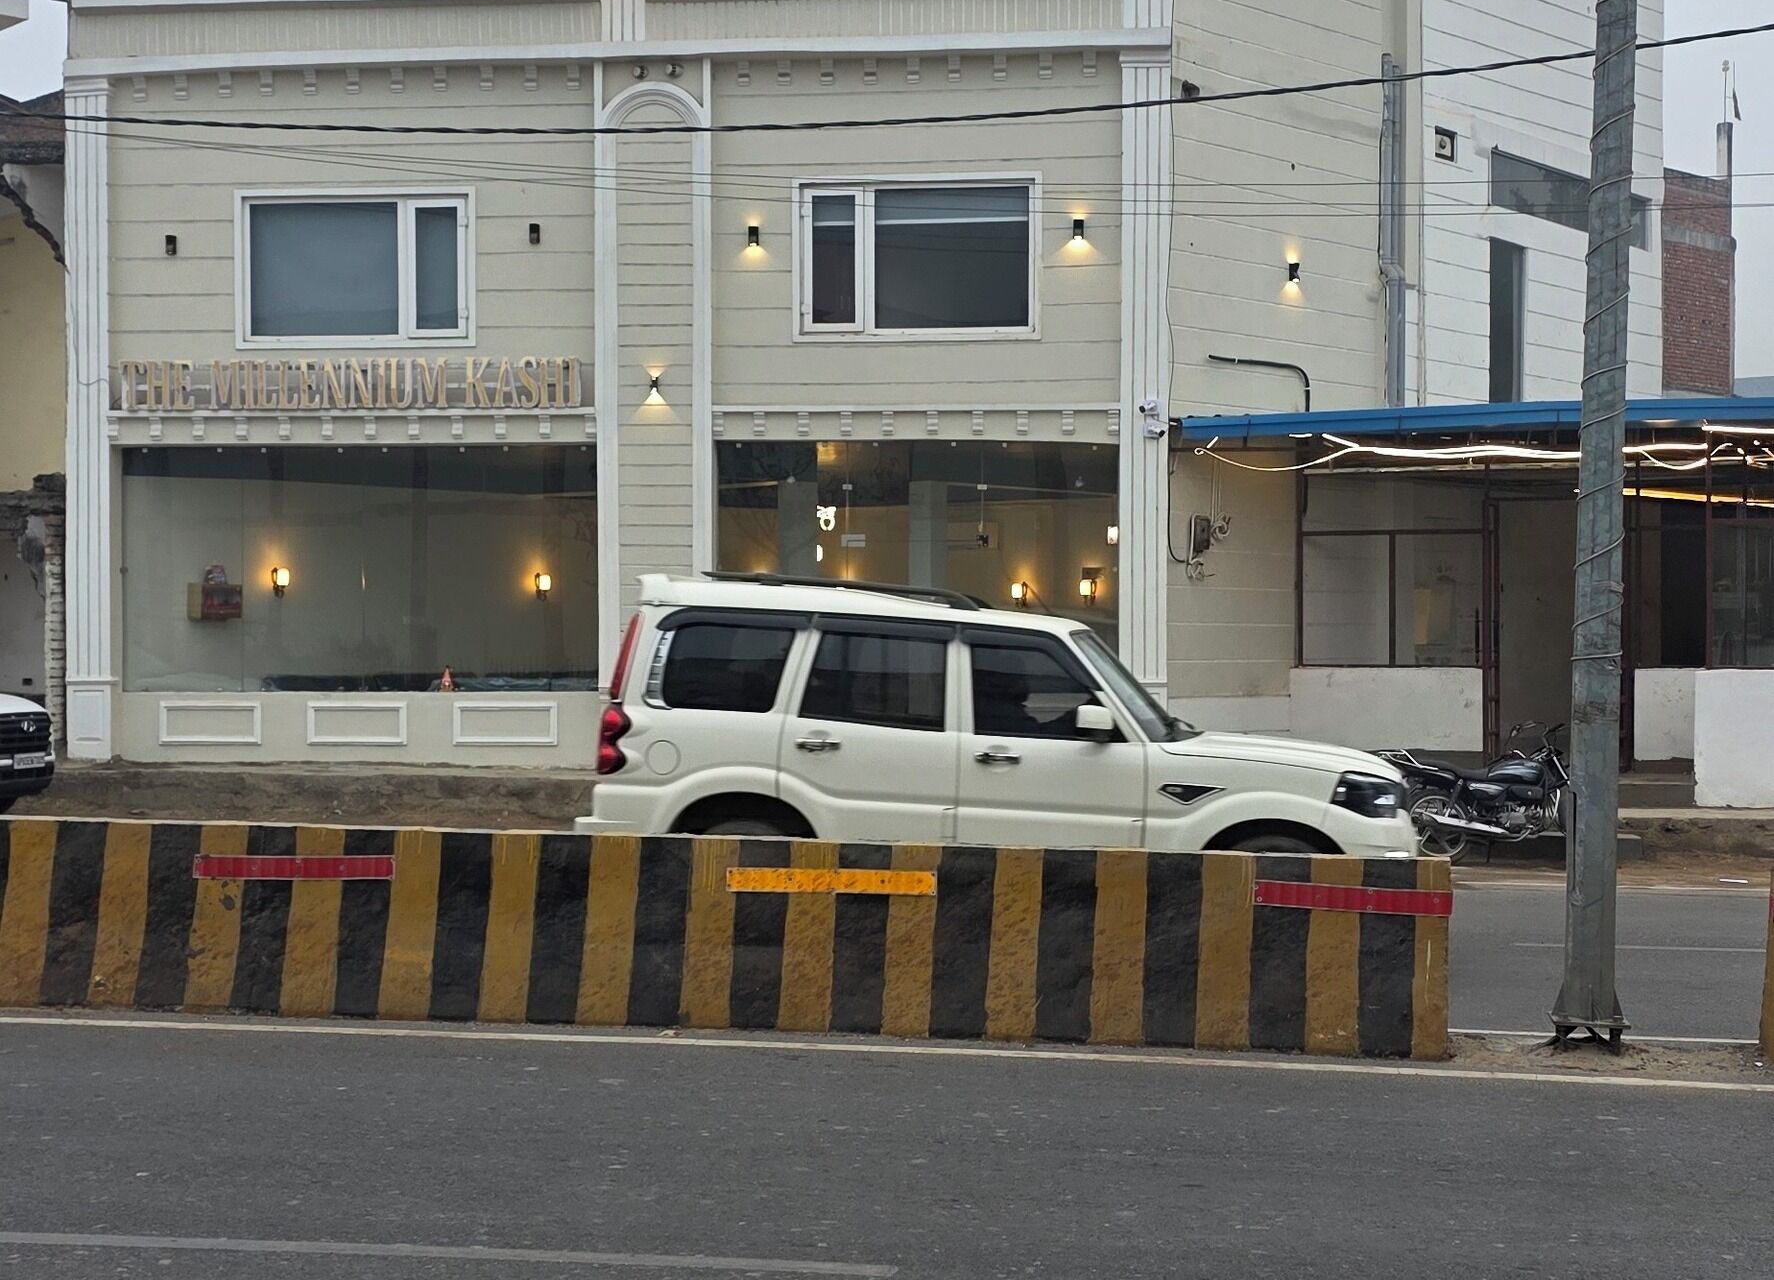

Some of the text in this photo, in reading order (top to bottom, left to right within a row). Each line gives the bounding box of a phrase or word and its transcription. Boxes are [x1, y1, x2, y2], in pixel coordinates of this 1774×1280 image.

[120, 356, 583, 410] THE MILLENNIUM KASHI
